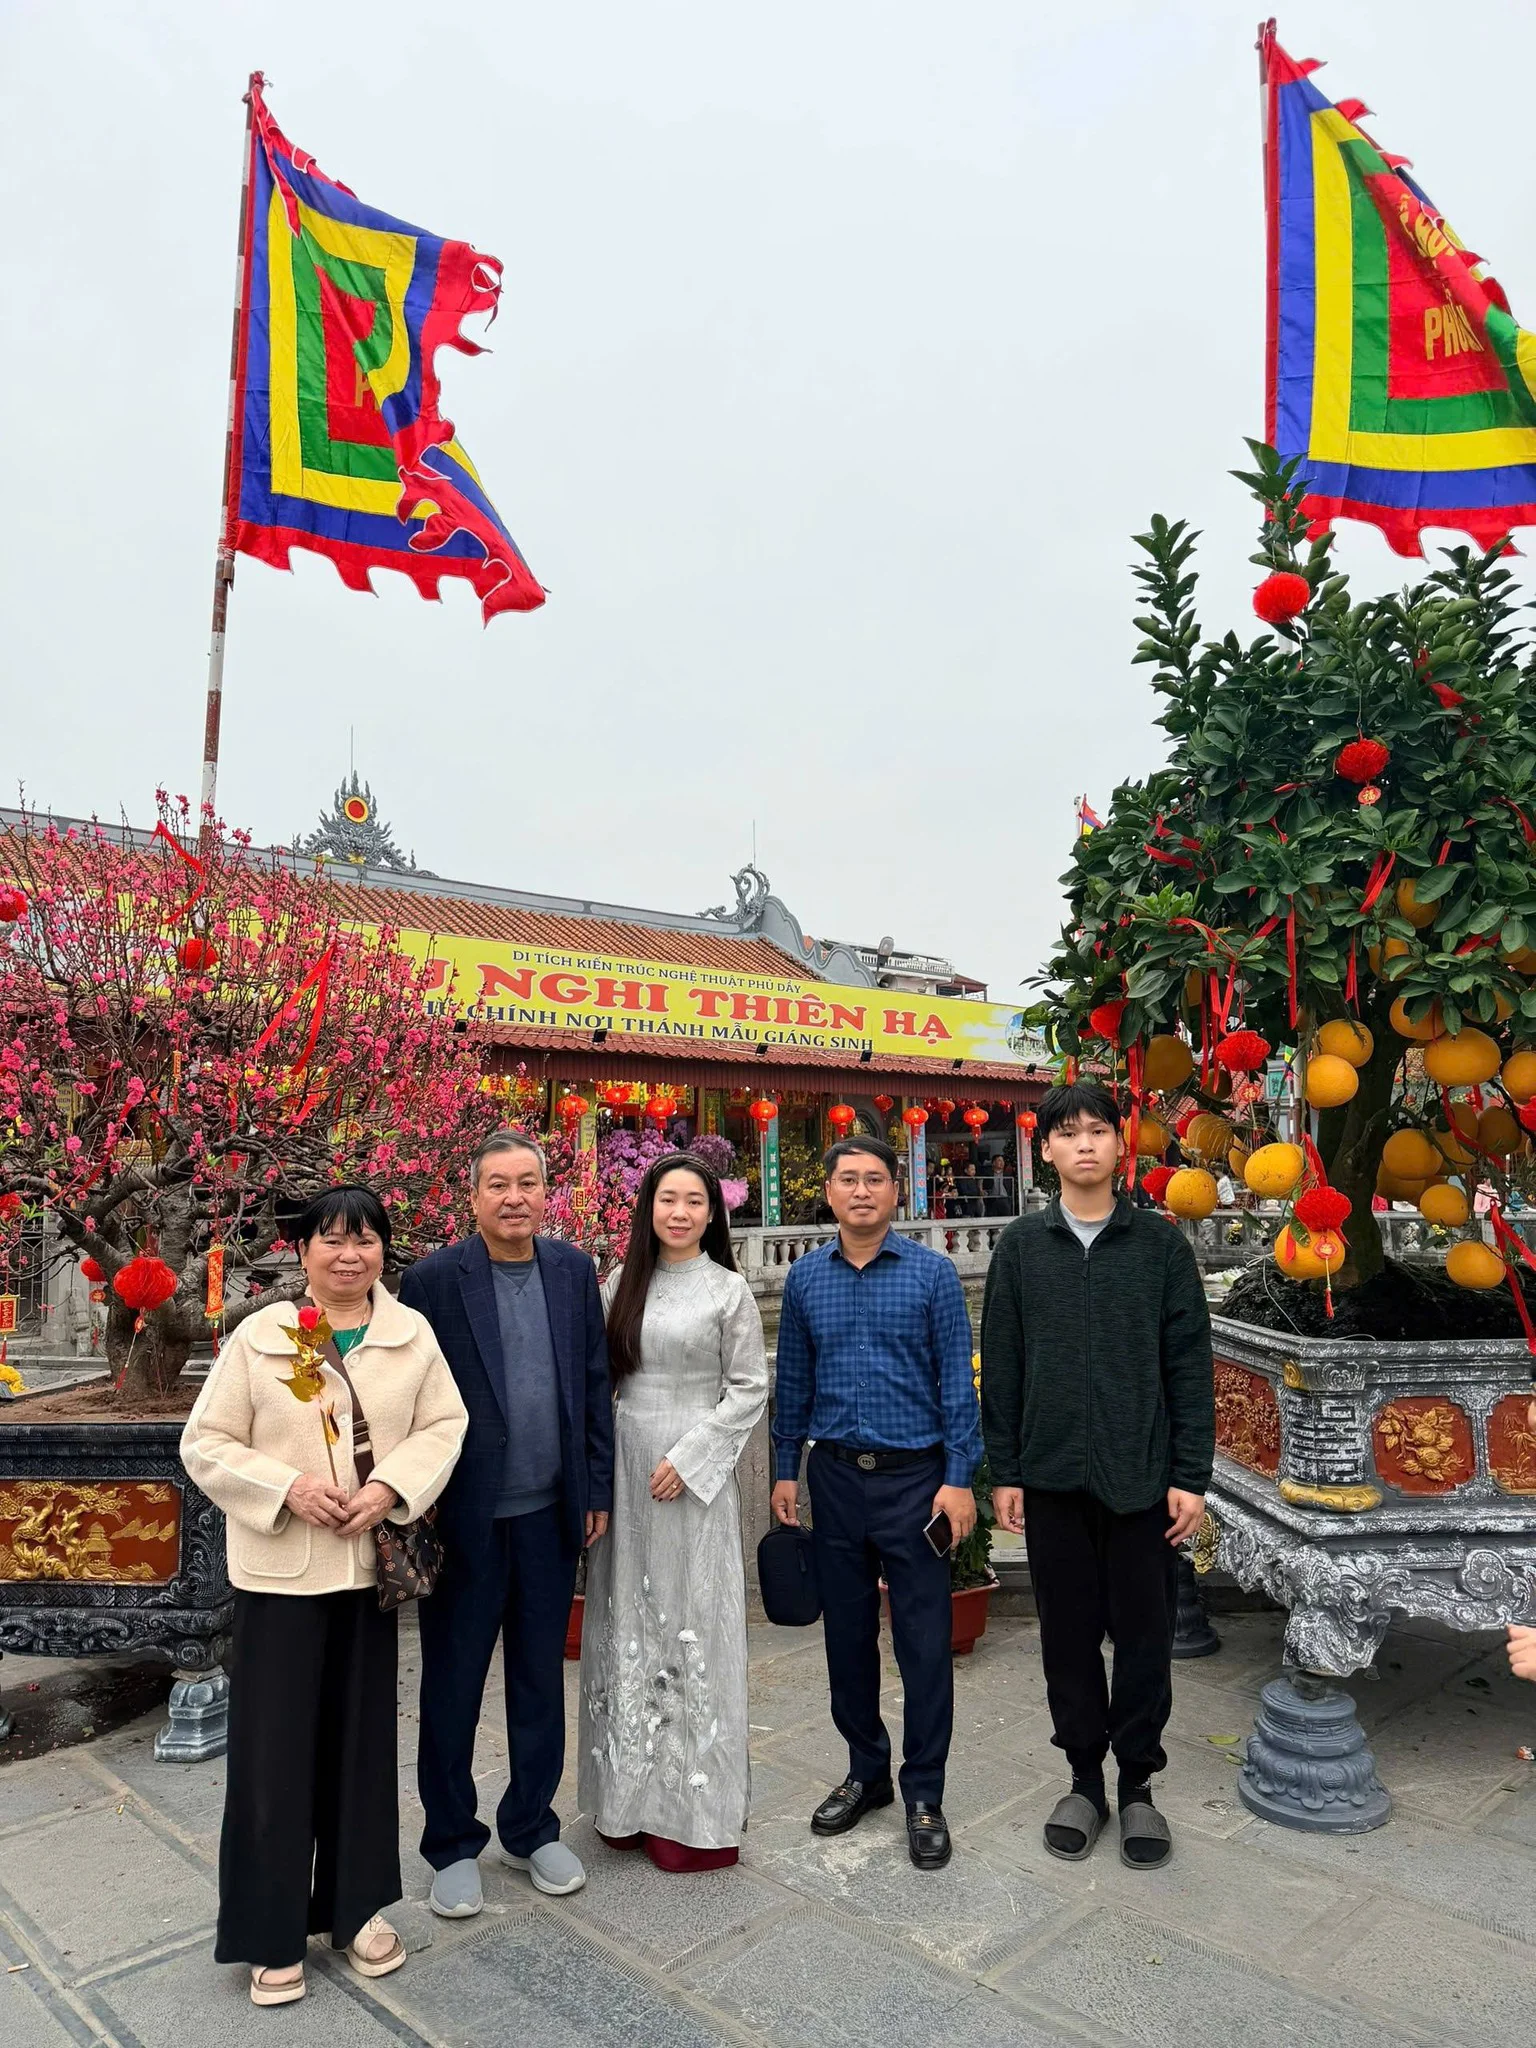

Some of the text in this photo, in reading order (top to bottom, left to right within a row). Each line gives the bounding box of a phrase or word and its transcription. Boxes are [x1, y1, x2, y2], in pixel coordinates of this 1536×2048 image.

[513, 950, 530, 962] DI
[534, 952, 572, 967] TÍCH
[577, 954, 612, 972] KIẾN
[616, 963, 655, 977] TRÚC
[659, 969, 697, 984] NGHỆ
[701, 974, 745, 989] THUẬT
[467, 1003, 556, 1025] CHÍNH
[566, 1013, 613, 1030] NƠI
[621, 1018, 704, 1037] THÁNH
[712, 1022, 758, 1041] MẪU
[764, 1030, 825, 1046] GIÁNG
[830, 1036, 873, 1050] SINH
[478, 964, 670, 1012] NGHI
[689, 989, 868, 1031] THIÊN
[882, 1009, 952, 1045] HẠ
